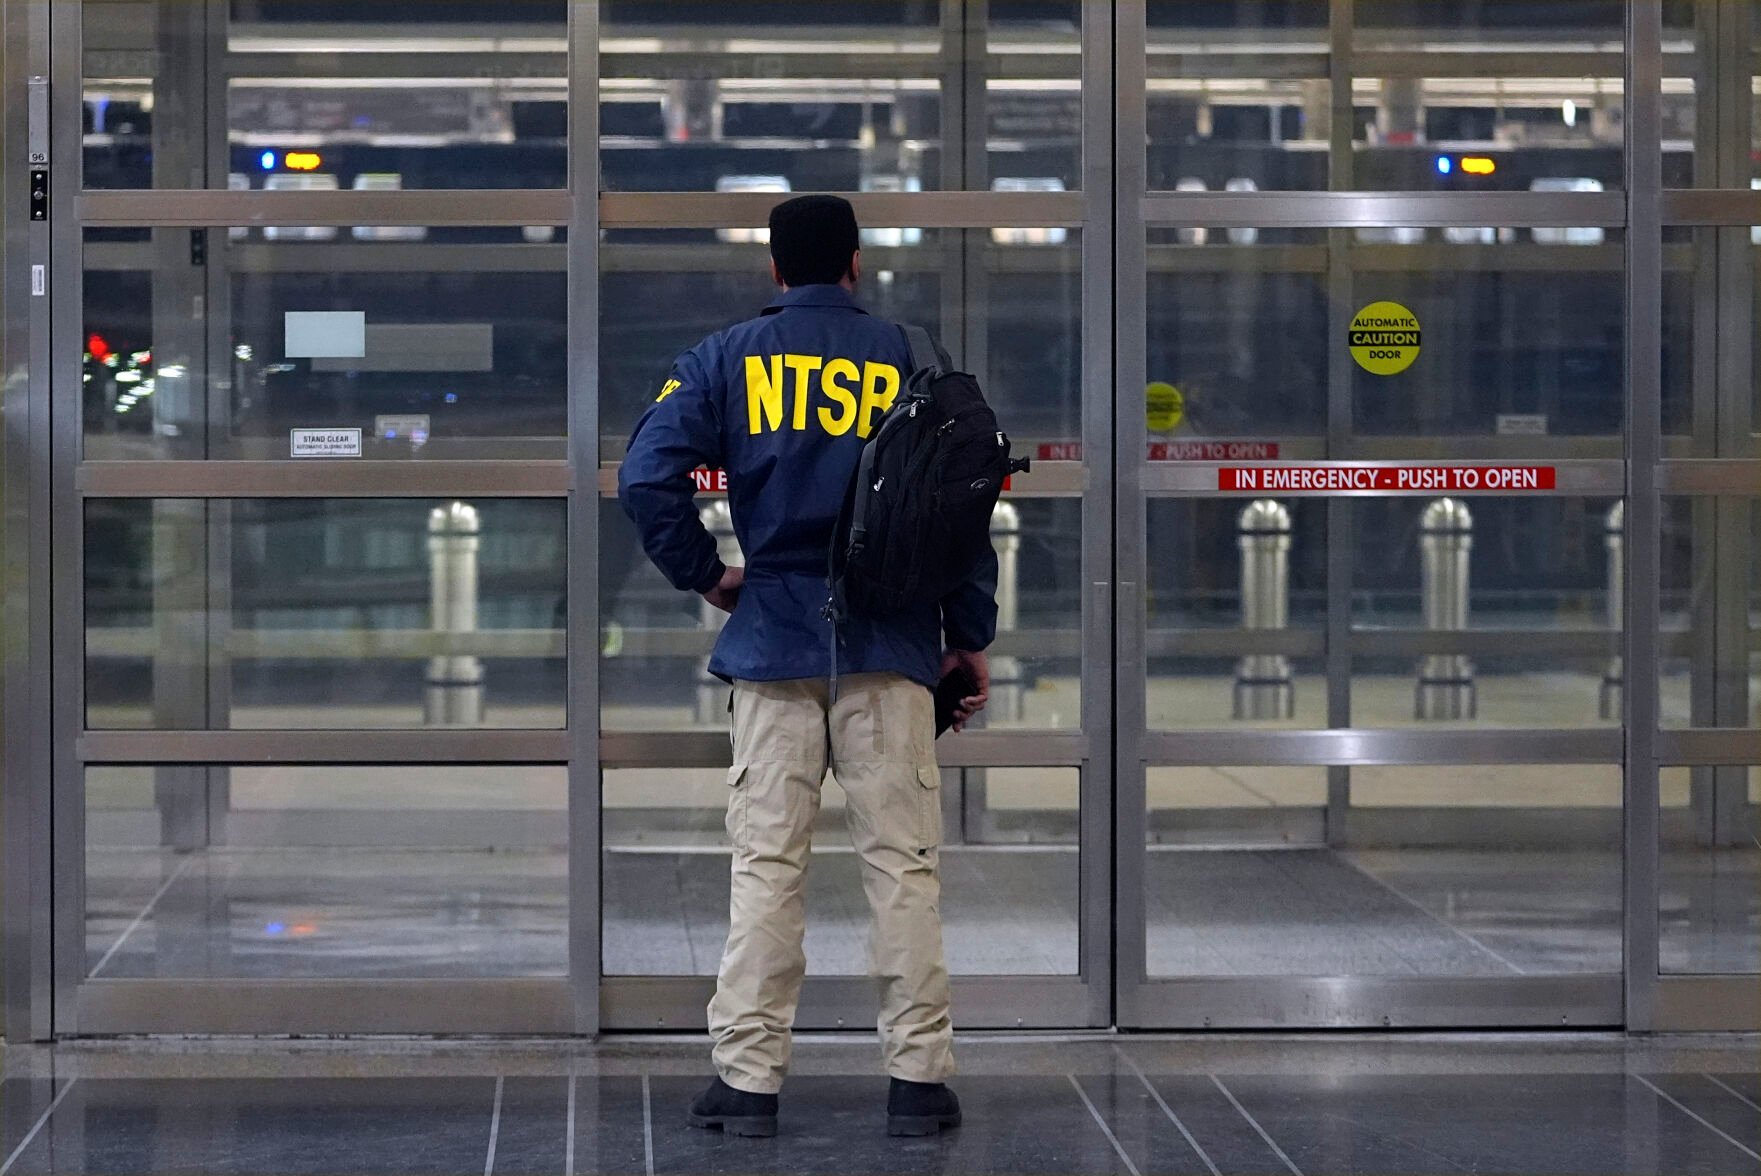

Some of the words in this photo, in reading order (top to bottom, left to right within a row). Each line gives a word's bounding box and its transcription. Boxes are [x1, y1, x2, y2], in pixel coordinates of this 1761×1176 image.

[32, 153, 45, 161] 96
[1354, 318, 1415, 327] AUTOMATIC
[1353, 332, 1417, 345] CAUTION
[1369, 350, 1401, 359] DOOR
[745, 354, 900, 439] NTSB
[1166, 443, 1202, 459] PUSH
[1207, 443, 1224, 459] TO
[1228, 443, 1267, 458] OPEN
[1235, 469, 1256, 488] IN
[1263, 469, 1379, 488] EMERGENCY
[1398, 469, 1446, 488] PUSH
[1453, 469, 1478, 488] TO
[1484, 468, 1538, 487] OPEN
